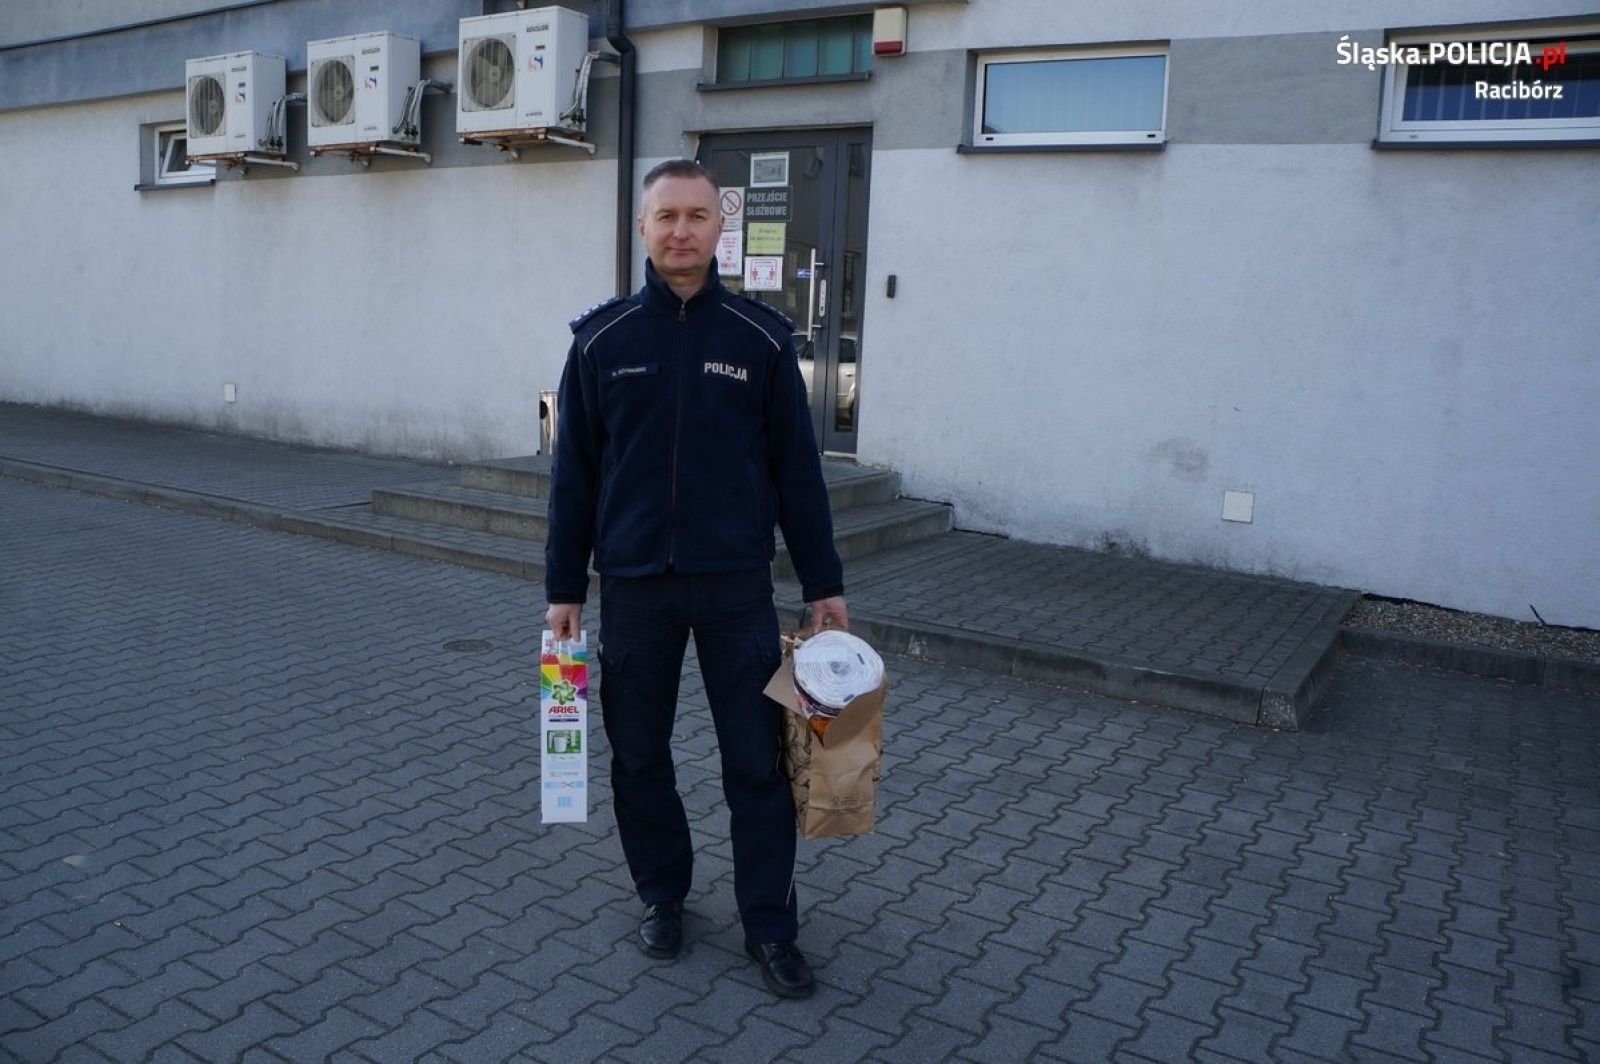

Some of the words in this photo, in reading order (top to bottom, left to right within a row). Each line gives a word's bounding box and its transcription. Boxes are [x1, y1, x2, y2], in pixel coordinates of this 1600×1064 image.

[746, 190, 788, 203] PRZEJŚCIE
[746, 204, 787, 216] SŁUŻBOWE
[704, 362, 748, 381] POLICJA
[548, 705, 580, 714] ARIEL
